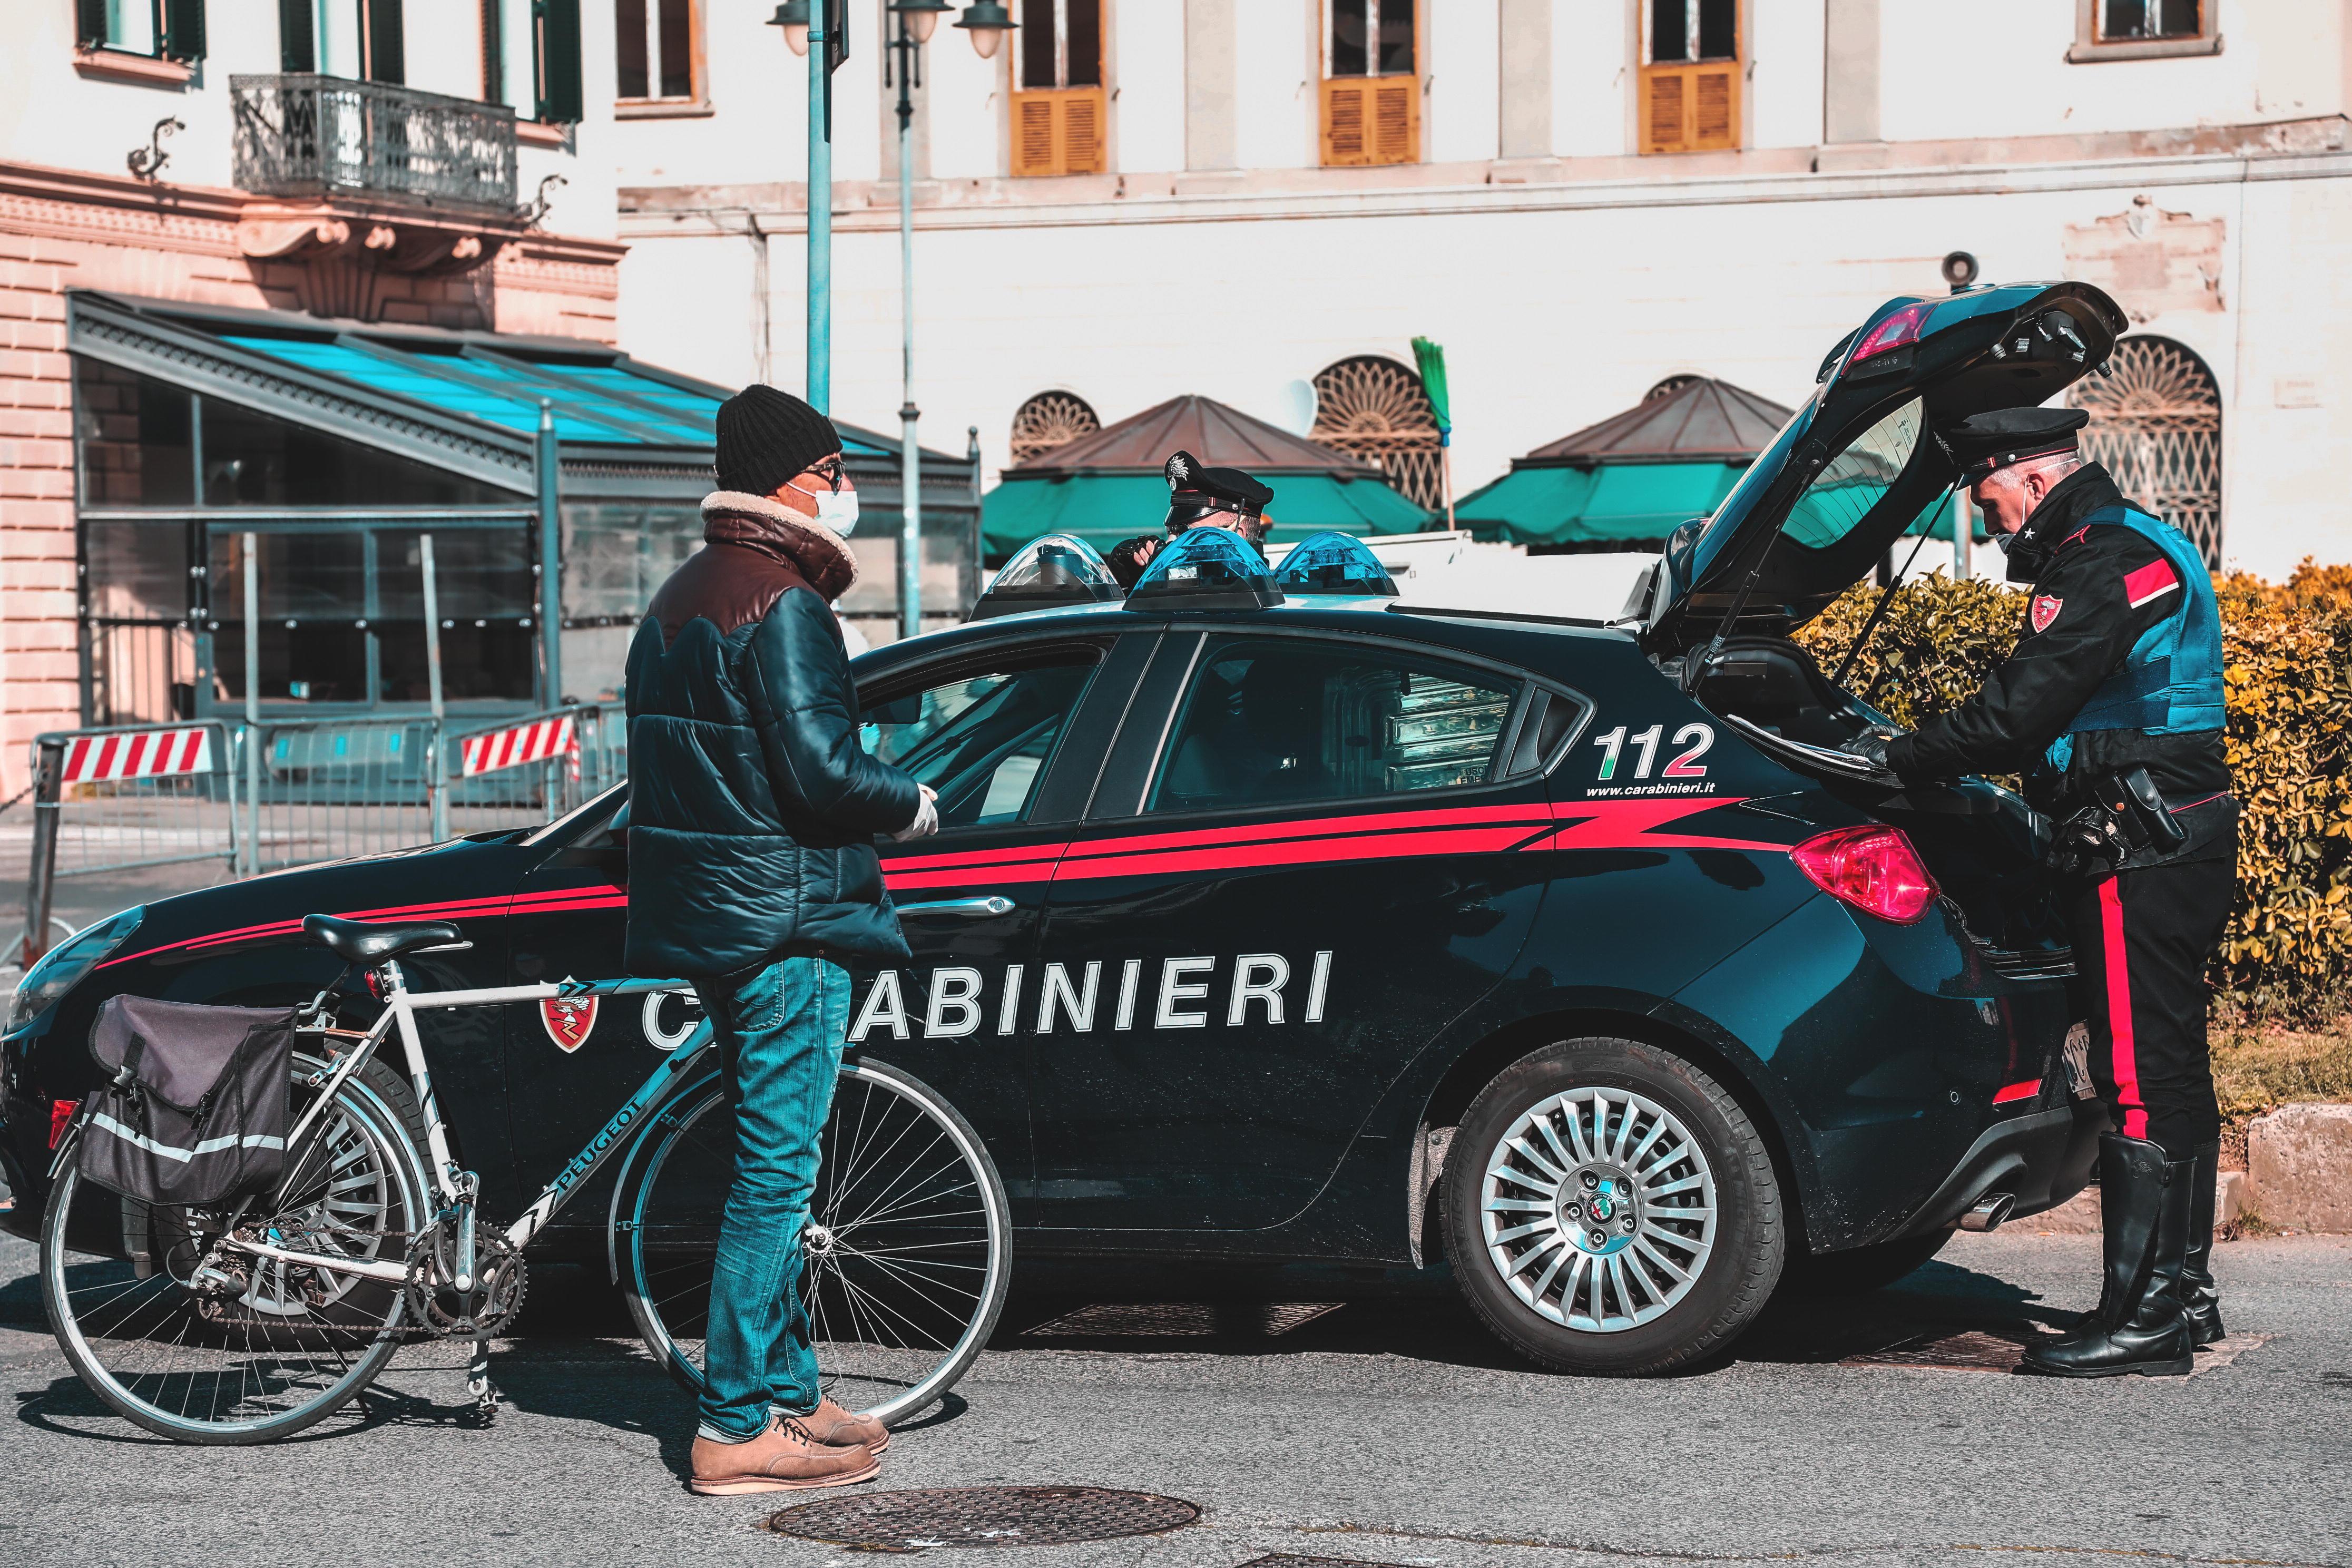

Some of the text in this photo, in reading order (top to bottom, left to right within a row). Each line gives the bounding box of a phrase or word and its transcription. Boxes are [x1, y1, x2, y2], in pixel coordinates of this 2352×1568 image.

[1594, 723, 1714, 780] 112
[1586, 782, 1716, 797] www.carabinieri.it
[641, 950, 1333, 1051] CABINIERI
[556, 1096, 643, 1191] PEUGEOT
[1594, 1194, 1614, 1204] ROMEO
